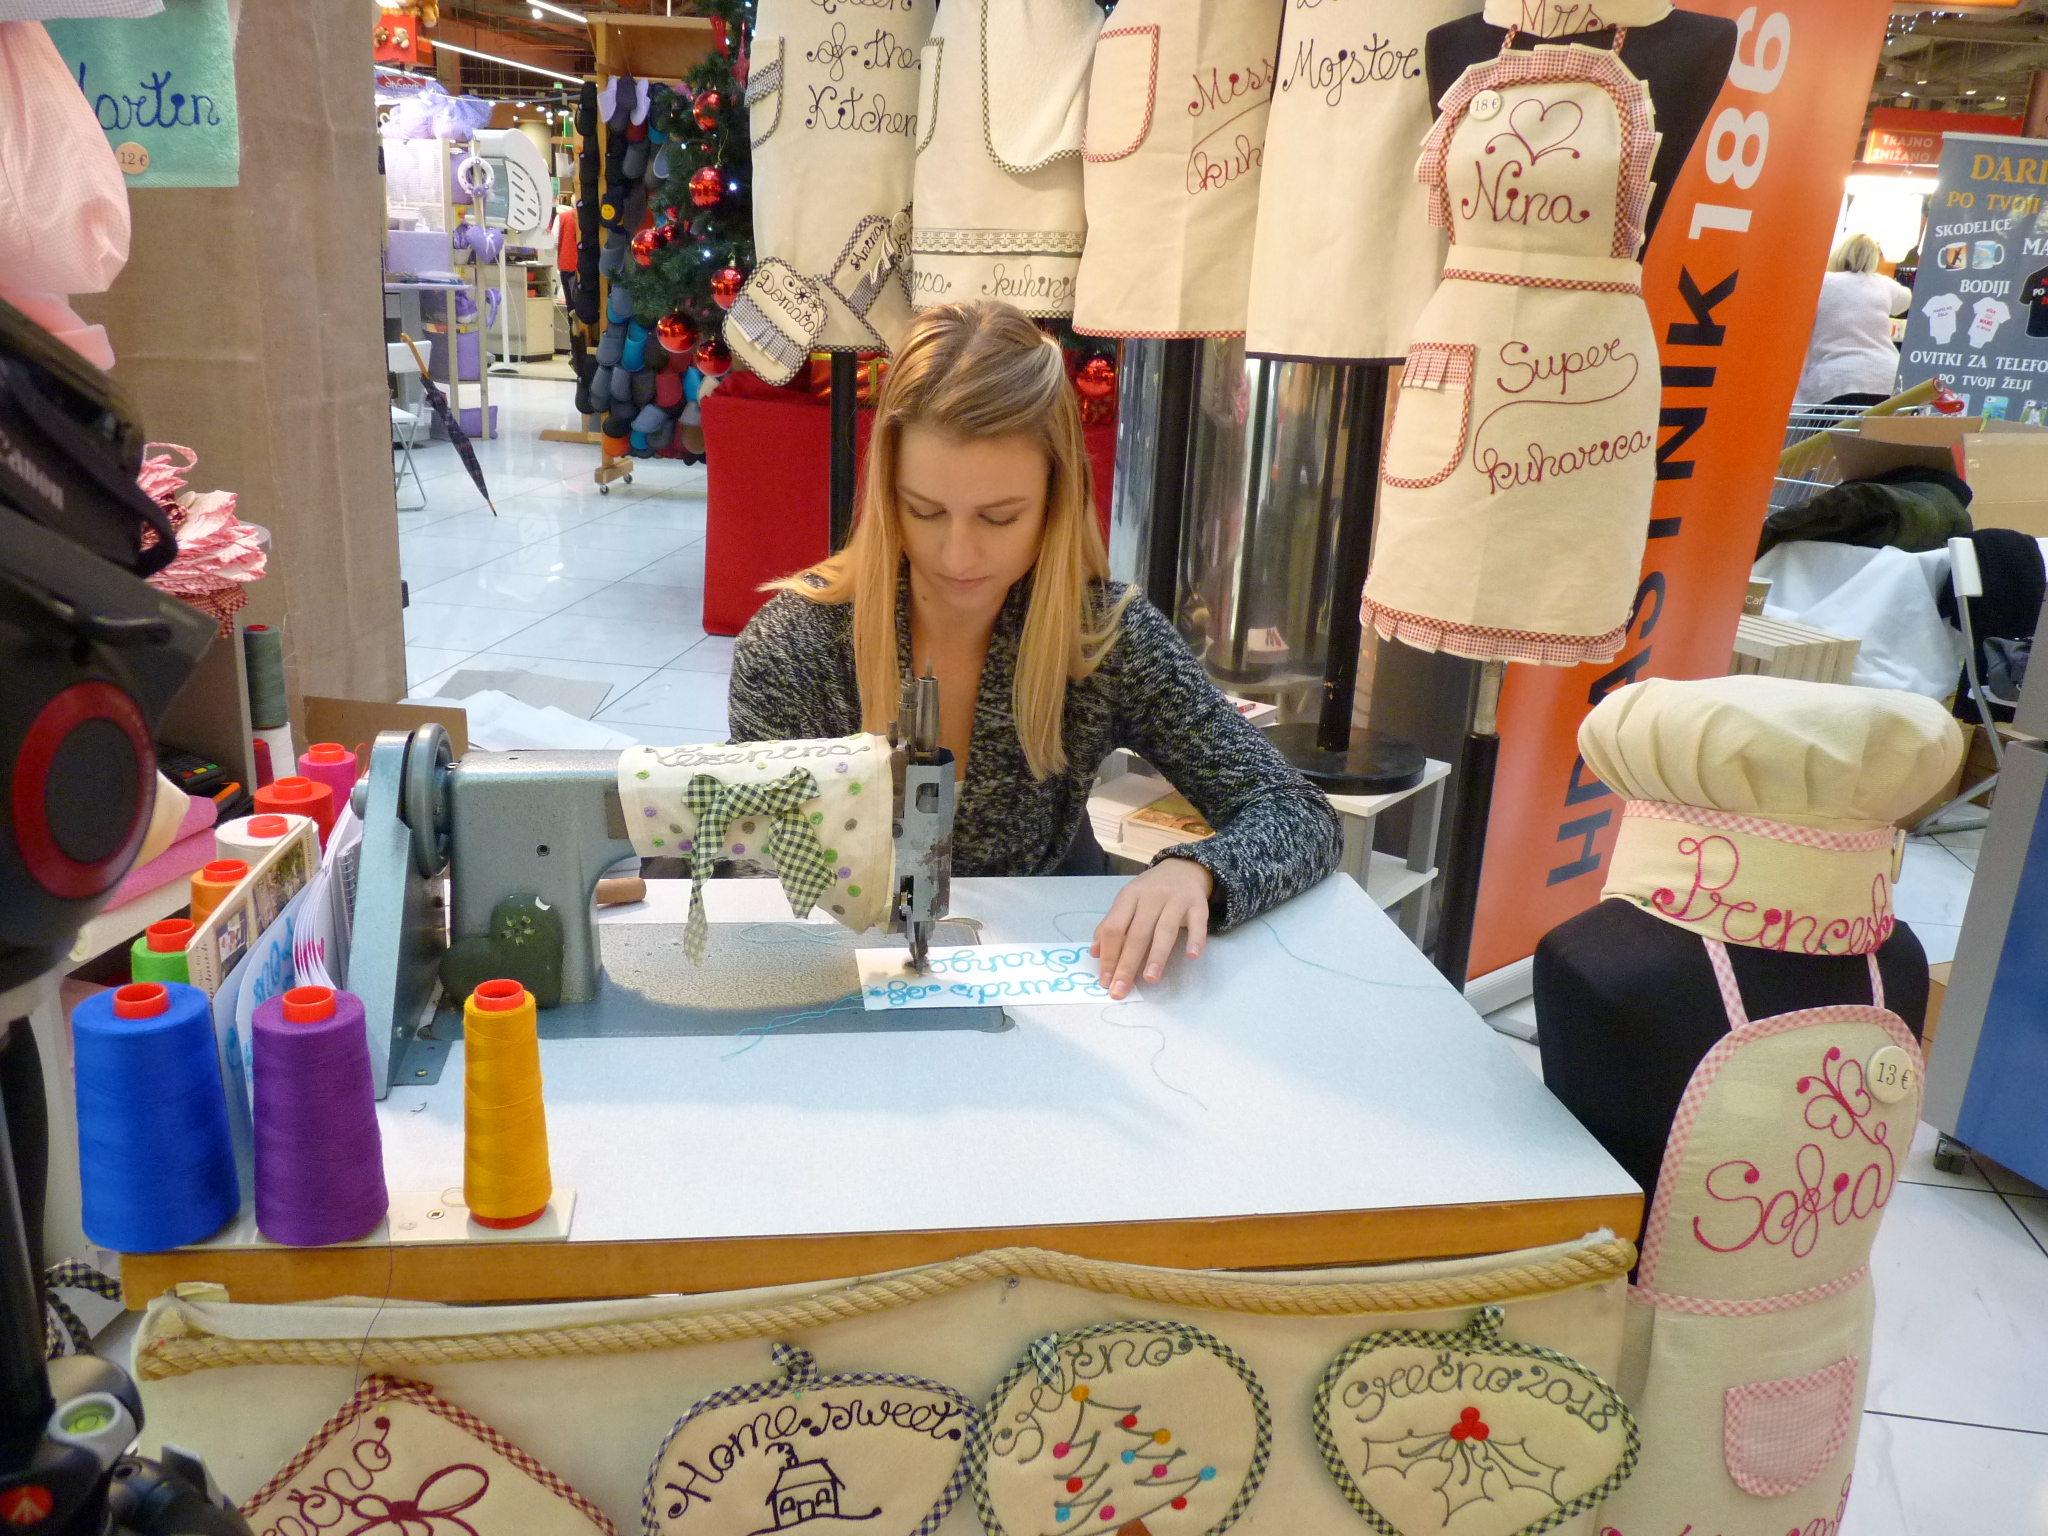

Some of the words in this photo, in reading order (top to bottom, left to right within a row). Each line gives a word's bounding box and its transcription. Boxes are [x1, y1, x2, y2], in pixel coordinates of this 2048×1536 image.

[806, 21, 859, 82] of
[863, 28, 921, 69] the
[1282, 32, 1421, 107] Mojster
[78, 62, 221, 131] artin
[1474, 99, 1489, 112] 18
[121, 152, 136, 165] 12
[1871, 147, 1931, 162] ZNIŽANO
[1882, 134, 1934, 148] TRAJNO
[1461, 160, 1590, 225] Nina
[1947, 190, 1976, 209] PO
[1986, 193, 2042, 217] TVOJI
[1935, 219, 2013, 238] SKODELICE
[1959, 279, 2011, 298] BODIJI
[1497, 338, 1638, 395] Super
[1909, 350, 1963, 367] OVITKI
[1967, 354, 1988, 369] ZA
[1938, 373, 1956, 385] PO
[1961, 375, 1996, 390] TVOJI
[2001, 376, 2033, 393] ŽELJI
[0, 428, 66, 511] anon
[1474, 430, 1652, 495] kuharica
[1876, 1062, 1898, 1086] 13
[1900, 1068, 1913, 1090] €
[1692, 1143, 1894, 1258] Sofia
[1517, 1365, 1619, 1434] 2018
[262, 1416, 392, 1536] ečno
[664, 1405, 812, 1520] Home
